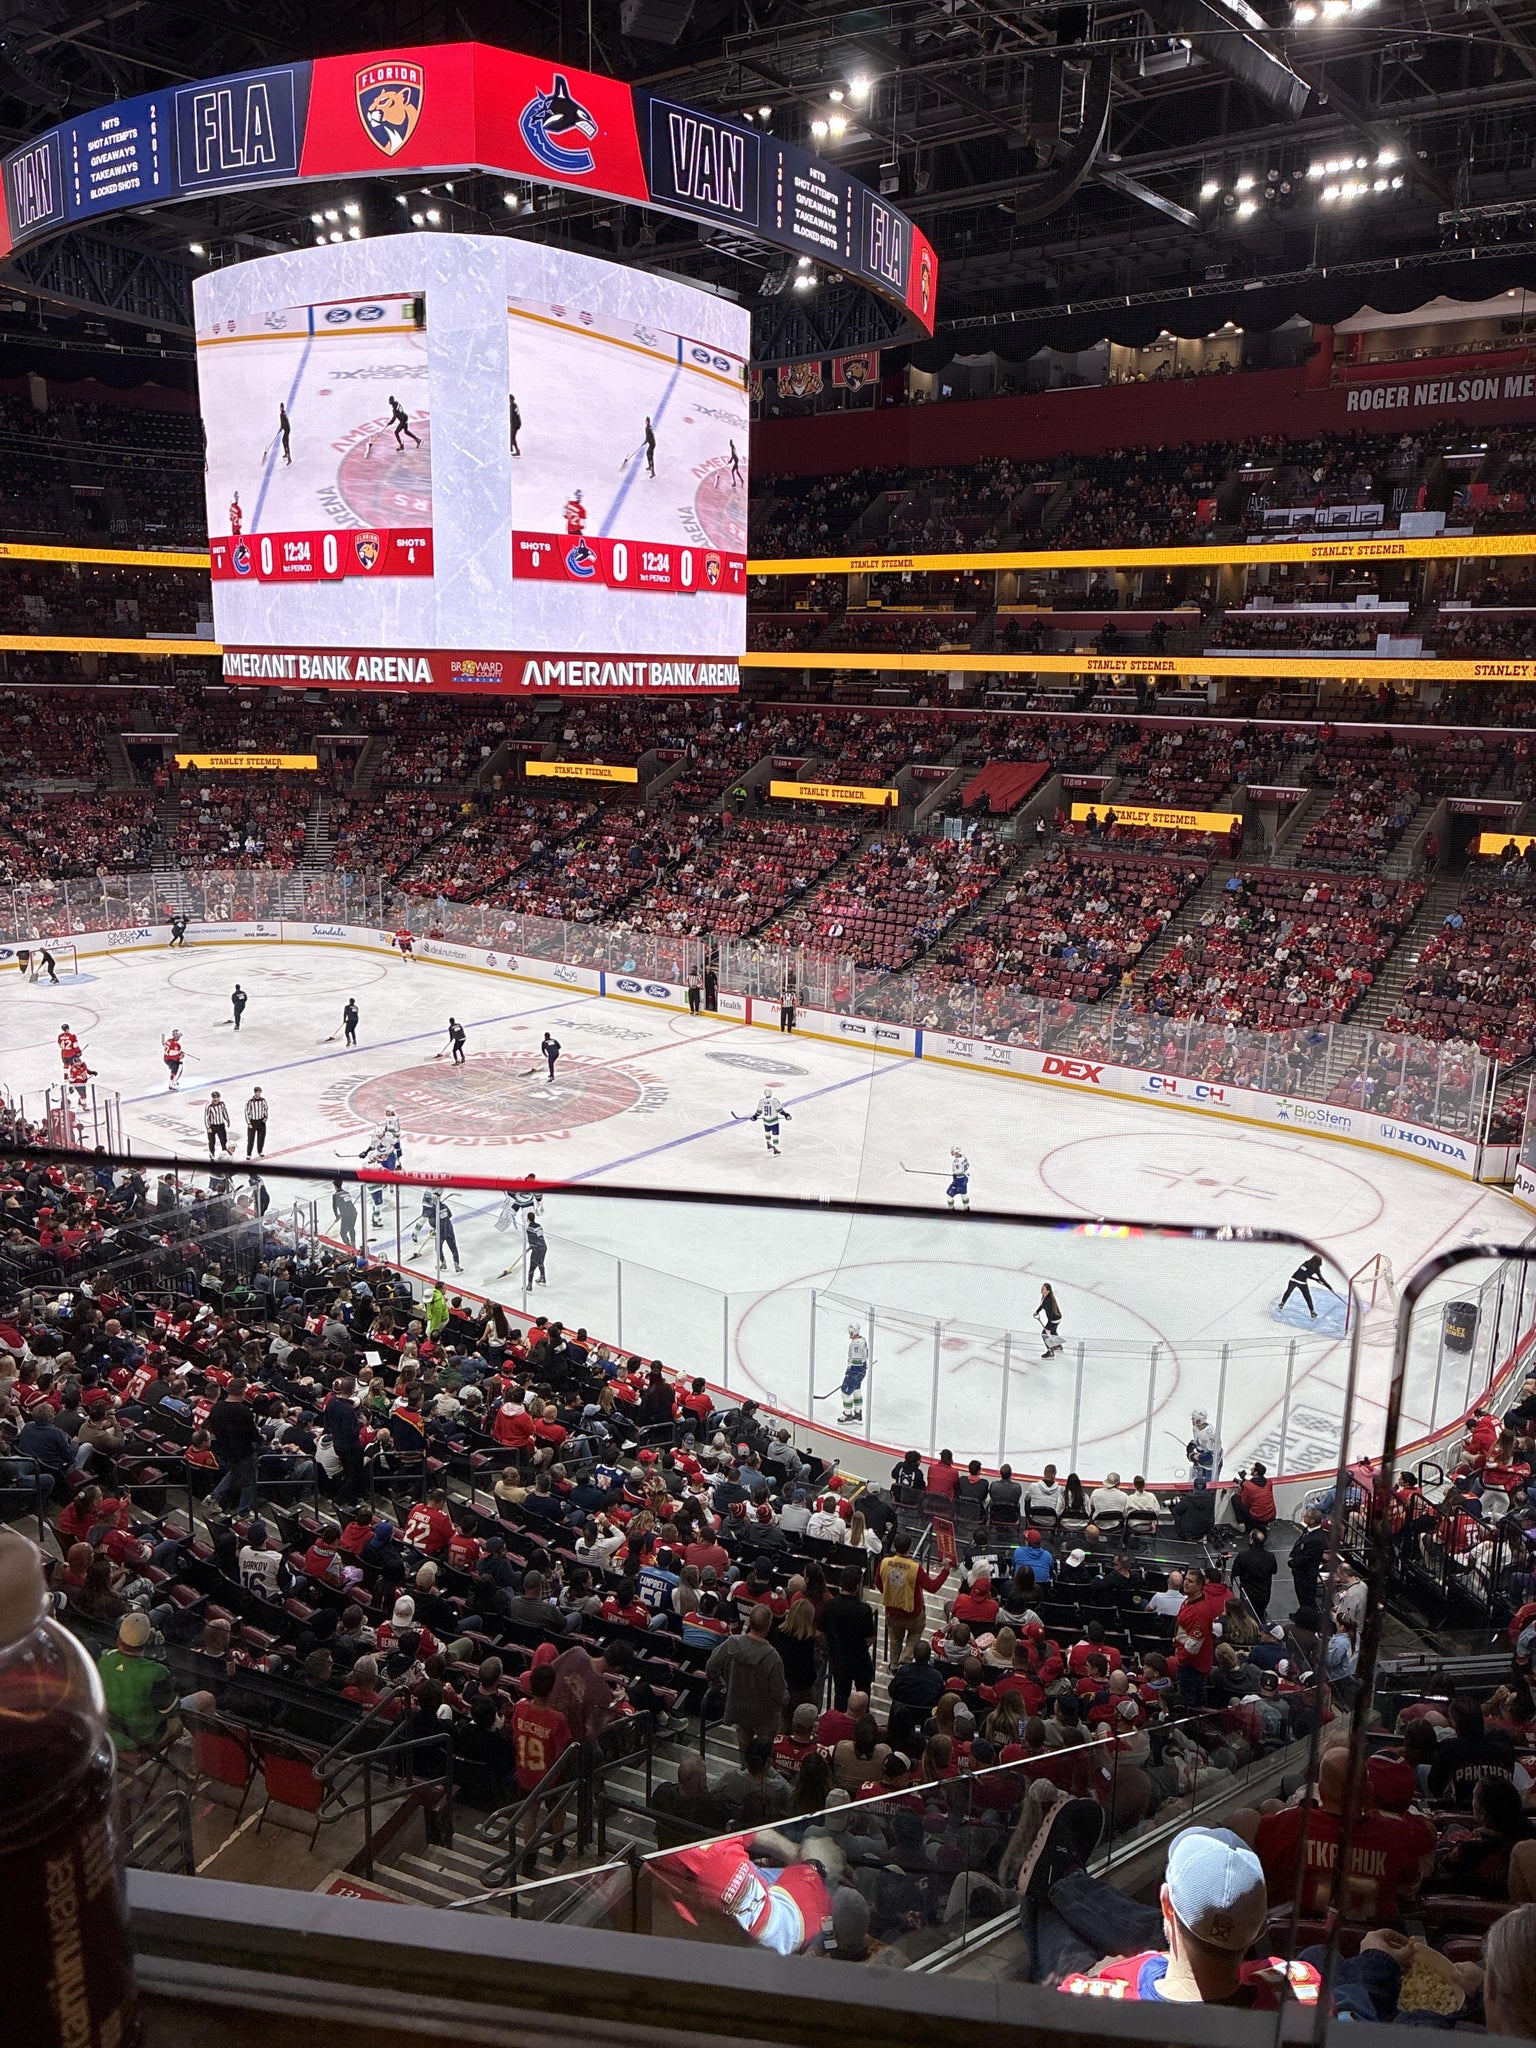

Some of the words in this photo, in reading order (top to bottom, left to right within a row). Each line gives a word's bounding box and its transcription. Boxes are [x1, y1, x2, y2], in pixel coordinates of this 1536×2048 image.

[360, 67, 418, 88] FLORIDA
[101, 116, 120, 131] HITS
[193, 82, 277, 174] FLA
[88, 137, 103, 152] SHOT
[103, 128, 138, 147] ATTEMPTS
[91, 145, 136, 167] GIVEAWAYS
[670, 112, 744, 212] VAN
[90, 161, 139, 183] TAKEAWAYS
[809, 167, 826, 183] HITS
[13, 144, 53, 229] VAN
[90, 183, 118, 200] BLOCKED
[118, 177, 141, 192] SHOTS
[794, 176, 811, 192] SHOT
[796, 193, 837, 219] GIVEAWAYS
[794, 208, 838, 235] TAKEAWAYS
[793, 223, 819, 243] BLOCKED
[869, 202, 902, 287] FLA
[1346, 385, 1409, 412] ROGER
[1413, 377, 1501, 407] NEILSON
[283, 541, 311, 562] 12:34
[396, 538, 426, 548] SHOTS
[520, 541, 551, 552] SHOTS
[1311, 546, 1355, 557] STANLEY
[261, 536, 273, 575] 0
[323, 533, 338, 574] 0
[407, 548, 415, 564] 4
[531, 551, 540, 567] 0
[612, 542, 628, 581] 0
[641, 551, 670, 573] 12:34
[293, 563, 313, 573] PERIOD
[680, 549, 693, 587] 0
[850, 560, 879, 569] STANLEY
[649, 573, 671, 583] PERIOD
[222, 652, 299, 679] AMERANT
[299, 655, 351, 681] BANK
[354, 656, 434, 684] ARENA
[521, 659, 648, 686] AMERANT
[648, 661, 696, 686] BANK
[696, 663, 741, 687] ARENA
[1087, 660, 1128, 670] STANLEY
[1474, 664, 1530, 676] STANLEY
[209, 757, 244, 766] STANLEY
[554, 766, 584, 775] STANLEY
[799, 786, 830, 797] STANLEY
[1249, 789, 1263, 799] 119
[1450, 802, 1467, 812] 120
[107, 930, 137, 940] OMEGA
[135, 928, 152, 940] XL
[107, 937, 136, 947] SPORT
[620, 979, 639, 992] Ford
[649, 985, 667, 998] Ford
[719, 998, 742, 1011] Health
[60, 1039, 72, 1051] 42
[1041, 1056, 1105, 1084] DEX
[763, 1105, 773, 1117] 91
[1294, 1104, 1352, 1127] BioStem
[1294, 1118, 1351, 1133] TECHNOLOGIES
[1397, 1130, 1468, 1161] HONDA
[403, 1518, 431, 1549] 22
[243, 1560, 268, 1572] BARKOV
[639, 1575, 668, 1593] CAMPBELL
[639, 1586, 663, 1608] 51
[517, 1733, 546, 1771] 19
